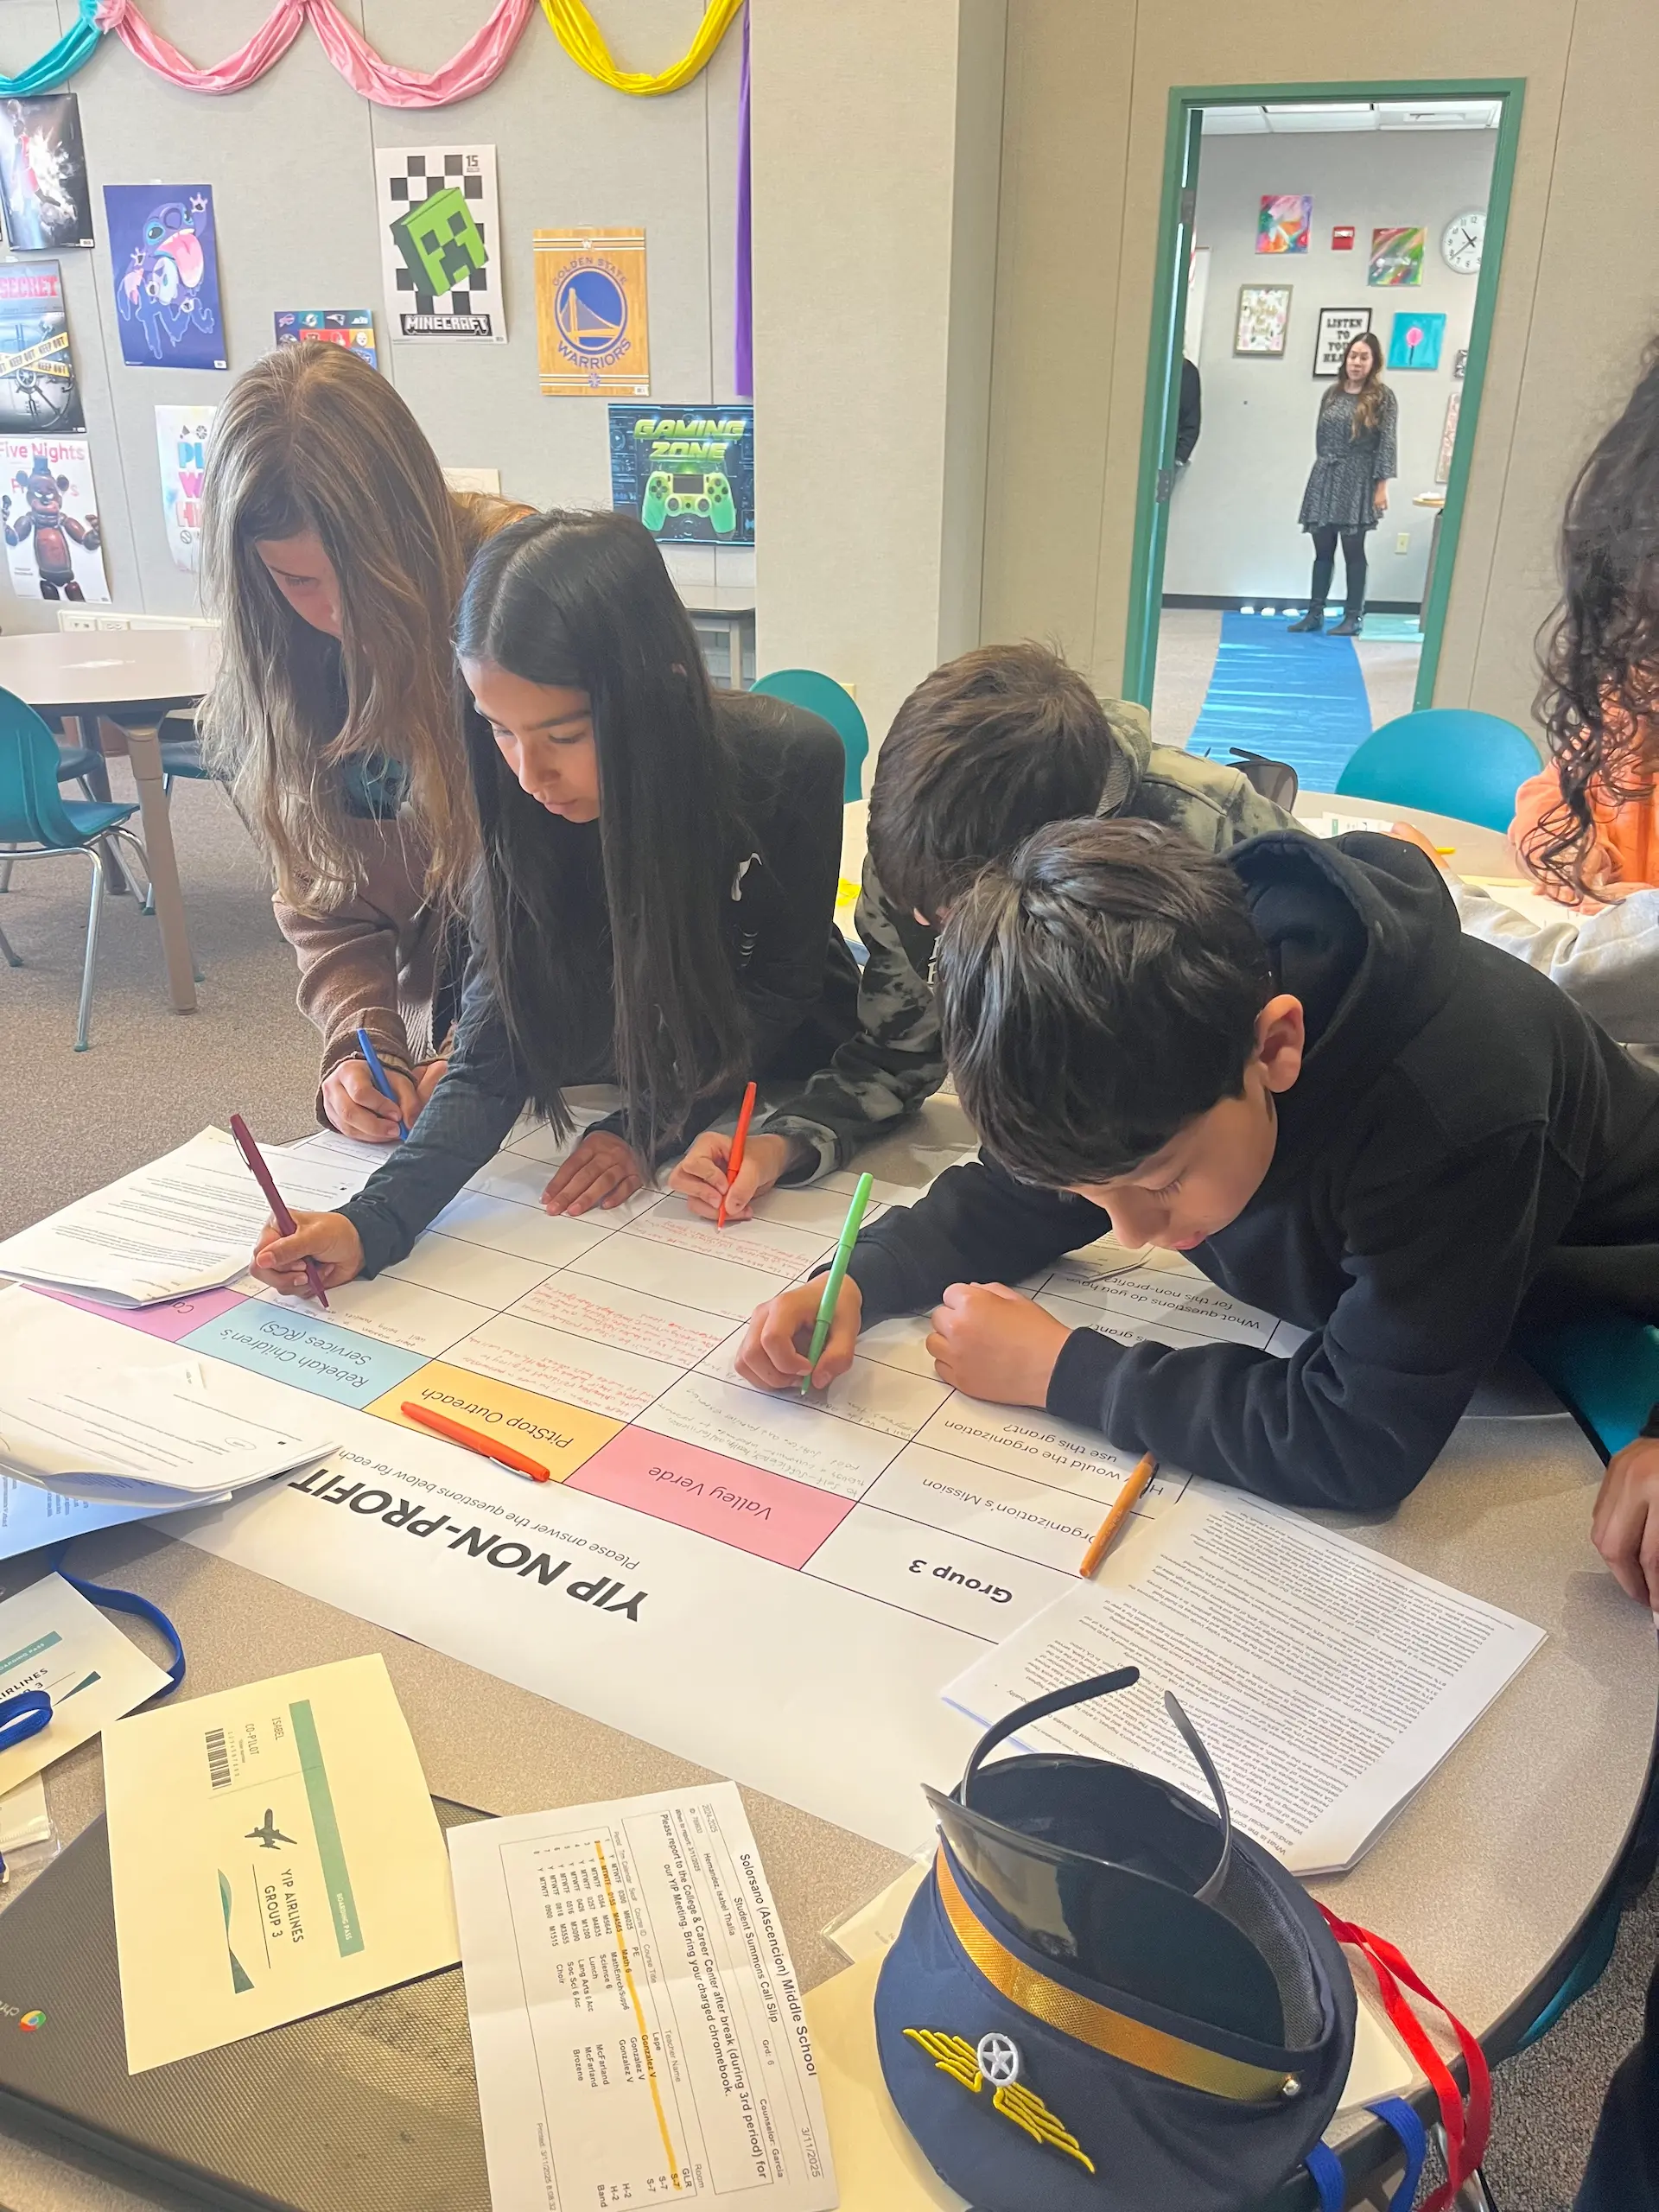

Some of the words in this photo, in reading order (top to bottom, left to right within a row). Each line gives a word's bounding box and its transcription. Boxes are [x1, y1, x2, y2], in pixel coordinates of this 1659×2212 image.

[466, 155, 479, 167] 15
[552, 257, 594, 286] GOLDEN
[596, 257, 629, 286] STATE
[0, 276, 58, 298] SECRET
[405, 315, 488, 333] MINECRAFT
[1326, 318, 1363, 328] LISTEN
[1337, 330, 1350, 340] TO
[557, 338, 632, 370] WARRIORS
[633, 419, 747, 441] GAMING
[32, 442, 85, 462] Nights
[649, 442, 728, 462] ZONE
[1101, 1286, 1127, 1296] you
[1191, 1295, 1209, 1304] this
[1151, 1299, 1218, 1317] questions
[1212, 1300, 1233, 1310] for
[259, 1320, 307, 1341] (RCS)
[1221, 1313, 1259, 1329] What
[219, 1329, 296, 1361] Children's
[304, 1337, 372, 1365] Services
[298, 1357, 369, 1388] Rebekah
[422, 1388, 503, 1423] Outreach
[505, 1417, 574, 1448] PitStop
[944, 1421, 1038, 1454] organization
[1002, 1425, 1056, 1443] grant?
[338, 1450, 372, 1465] each
[1041, 1451, 1067, 1464] the
[1058, 1440, 1085, 1453] this
[1091, 1450, 1116, 1462] use
[370, 1463, 393, 1476] for
[648, 1466, 704, 1496] Verde
[1069, 1459, 1120, 1479] would
[391, 1471, 437, 1493] below
[922, 1478, 982, 1505] Mission
[436, 1487, 504, 1516] questions
[709, 1486, 772, 1520] Valley
[286, 1468, 572, 1586] NON-PROFIT
[505, 1512, 531, 1527] the
[530, 1523, 588, 1546] answer
[588, 1543, 640, 1570] Please
[908, 1559, 927, 1573] 3
[932, 1565, 1012, 1603] Group
[566, 1576, 648, 1622] YIP
[29, 1643, 45, 1654] PASS
[271, 1716, 284, 1741] ISABEL
[1052, 1717, 1072, 1730] issues
[245, 1723, 259, 1755] CO-PILOT
[1078, 1732, 1116, 1757] commitment
[659, 1814, 672, 1836] Please
[1233, 1809, 1249, 1818] and
[1248, 1817, 1270, 1831] social
[1247, 1827, 1259, 1836] the
[1269, 1830, 1294, 1846] and/or
[668, 1837, 681, 1859] report
[1266, 1839, 1286, 1855] What
[664, 1864, 673, 1877] our
[675, 1860, 683, 1869] to
[677, 1870, 687, 1883] the
[281, 1868, 294, 1887] YIP
[668, 1878, 679, 1891] YIP
[264, 1885, 281, 1926] GROUP
[672, 1893, 688, 1929] Meeting.
[682, 1882, 697, 1915] College
[284, 1892, 304, 1942] AIRLINES
[336, 1892, 348, 1924] BOARDING
[343, 1924, 353, 1940] PASS
[734, 1897, 751, 1930] Student
[683, 1930, 696, 1957] Bring
[695, 1925, 709, 1956] Career
[588, 1955, 598, 1980] Lunch
[740, 1853, 764, 1904] Solorsano
[756, 1906, 790, 1976] (Ascencion)
[781, 1979, 802, 2022] Middle
[796, 2025, 817, 2075] School
[745, 1931, 765, 1979] Summons
[688, 1959, 702, 1980] your
[703, 1959, 718, 1987] Center
[723, 1911, 734, 1936] Thalia
[762, 2039, 772, 2054] Grd:
[760, 1980, 773, 2000] Call
[696, 1982, 715, 2021] charged
[713, 1991, 726, 2013] after
[766, 2002, 778, 2023] Slip
[720, 2015, 734, 2045] break
[633, 1907, 643, 1929] Course
[643, 1943, 653, 1967] Course
[664, 2029, 676, 2058] Teacher
[671, 2060, 681, 2082] Name
[695, 2164, 704, 2188] Room
[708, 2024, 733, 2096] chromebook.
[577, 1958, 586, 1977] Lang
[595, 2044, 610, 2085] McFarland
[622, 2183, 632, 2198] H-2
[599, 1954, 610, 1982] Science
[619, 2038, 631, 2075] Gonzalez
[646, 2178, 656, 2192] S-7
[621, 1948, 630, 1967] Math
[641, 2034, 653, 2070] Gonzalez
[670, 2172, 680, 2187] S-7
[632, 1946, 640, 1957] PE
[652, 2031, 661, 2050] Lepe
[682, 2167, 692, 2188] GLR
[726, 2048, 744, 2089] (during
[556, 1963, 564, 1984] Choir
[572, 2049, 583, 2081] Brozene
[596, 2183, 608, 2208] Band
[630, 2037, 642, 2073] Gonzalez
[658, 2175, 668, 2190] S-7
[739, 2091, 752, 2111] 3rd
[584, 2046, 598, 2088] McFarland
[610, 2185, 620, 2201] H-2
[742, 2114, 763, 2157] period)
[760, 2098, 775, 2145] Counselor:
[772, 2147, 784, 2177] Garcia
[801, 2126, 821, 2177] 3/11/2025
[755, 2160, 766, 2178] for
